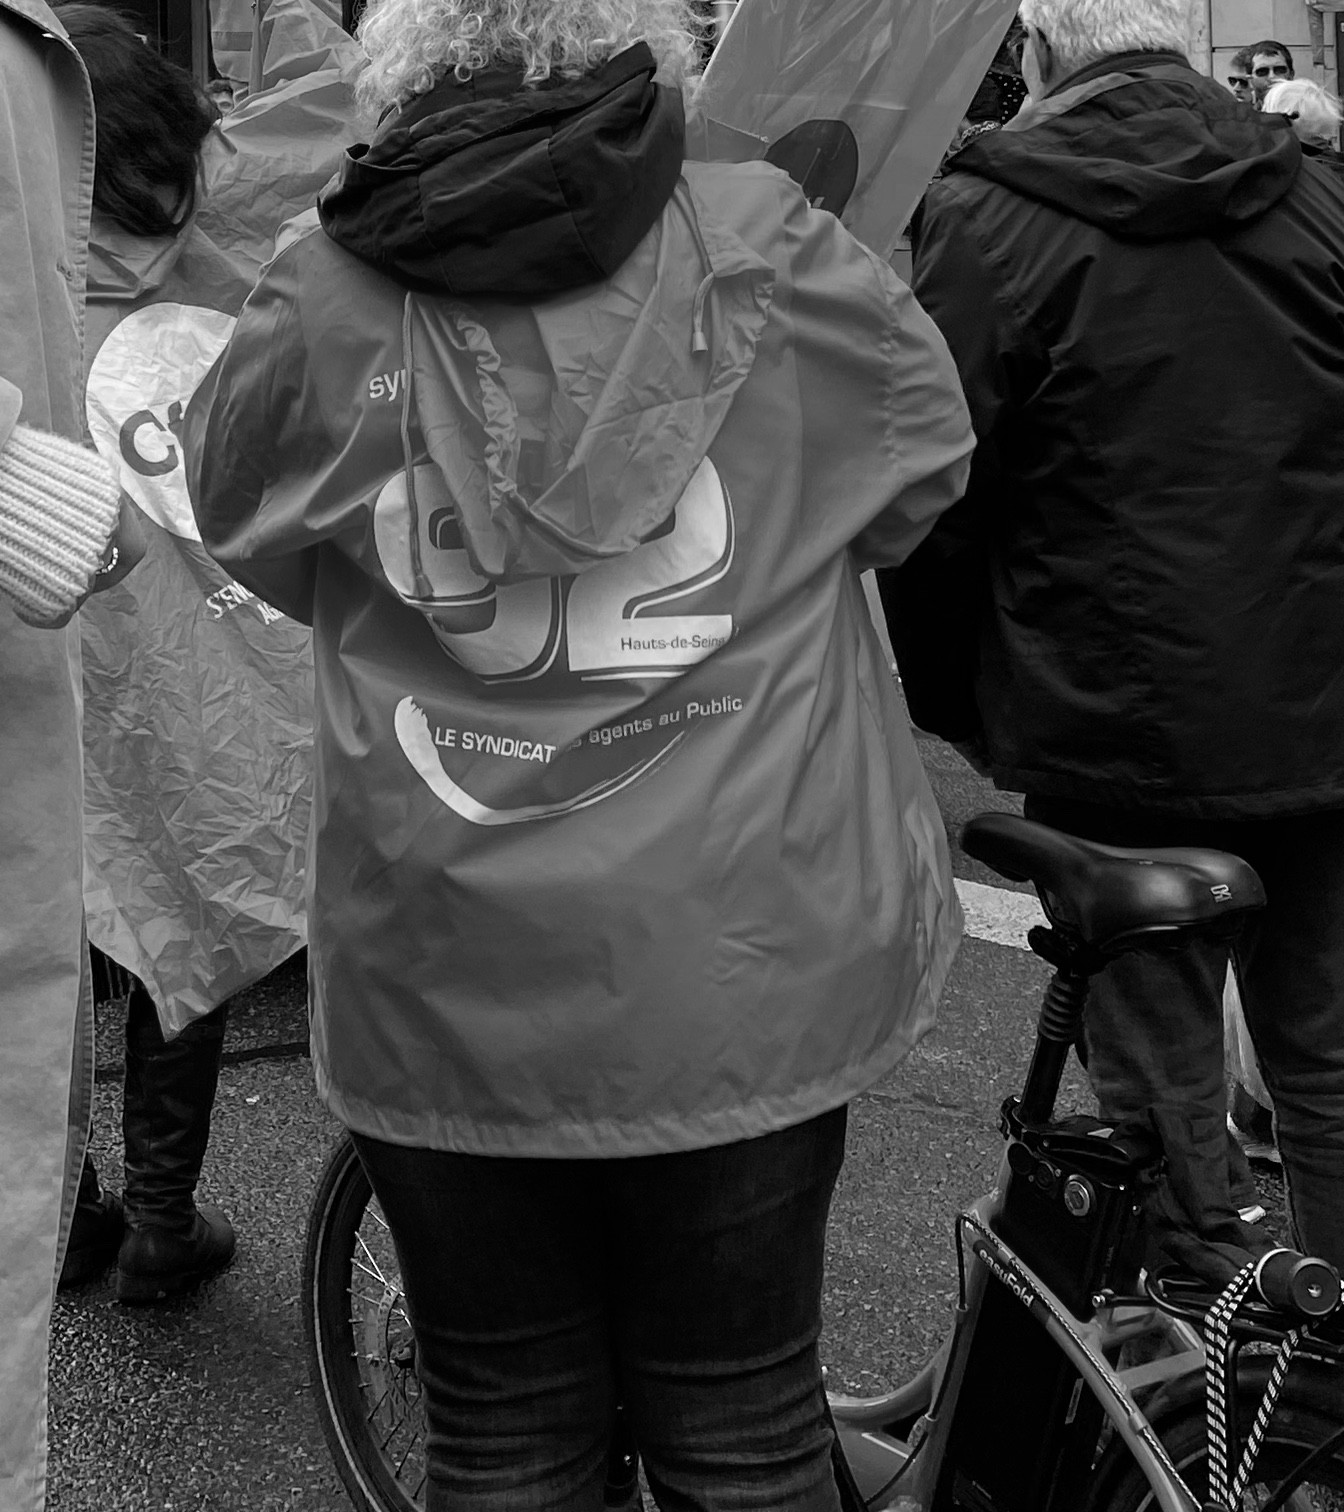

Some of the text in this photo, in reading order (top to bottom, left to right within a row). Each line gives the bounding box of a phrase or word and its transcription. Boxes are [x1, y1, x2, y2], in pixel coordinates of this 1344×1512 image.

[434, 726, 457, 748] LE
[461, 731, 558, 765] SYNDICAT
[589, 717, 653, 745] agents
[658, 710, 680, 727] au
[686, 694, 743, 719] Public
